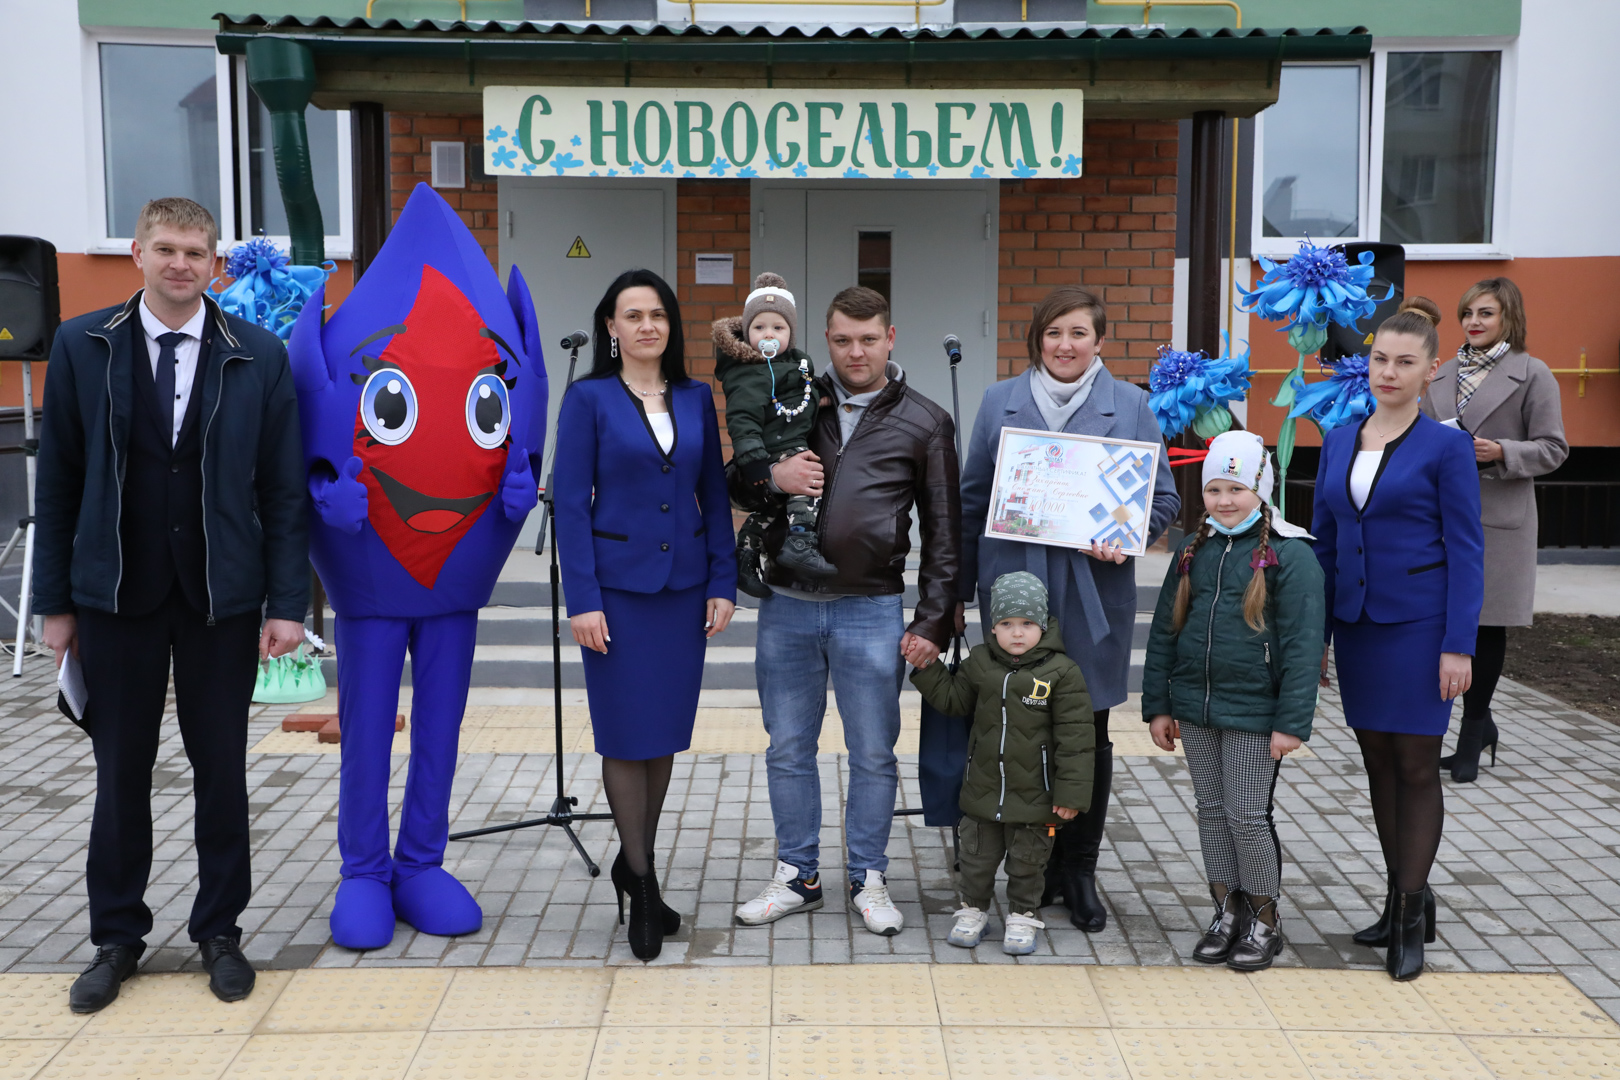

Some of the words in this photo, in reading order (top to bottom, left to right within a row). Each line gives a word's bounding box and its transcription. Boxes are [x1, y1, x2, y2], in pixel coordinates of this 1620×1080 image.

[517, 94, 555, 165] С
[586, 100, 1063, 168] НОВОСЕЛЬЕМ!
[1029, 677, 1051, 699] D
